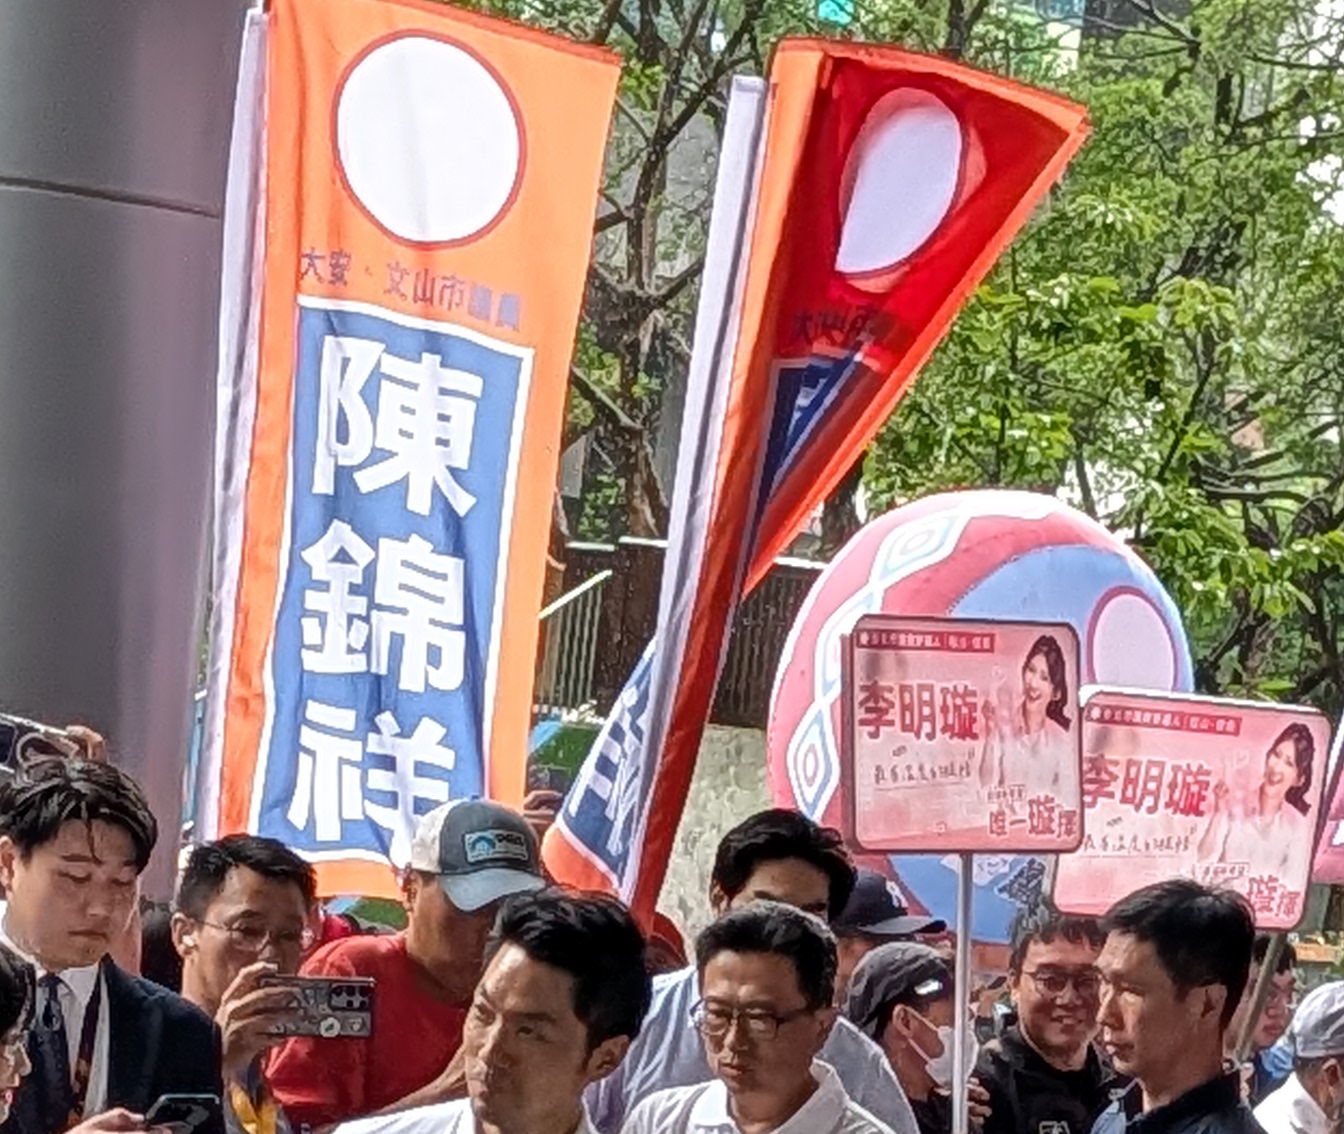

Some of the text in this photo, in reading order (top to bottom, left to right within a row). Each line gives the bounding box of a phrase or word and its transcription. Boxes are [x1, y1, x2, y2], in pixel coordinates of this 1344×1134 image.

[287, 335, 484, 866] 陳錦祥
[858, 682, 980, 741] 李明璇
[1083, 754, 1212, 818] 李明璇
